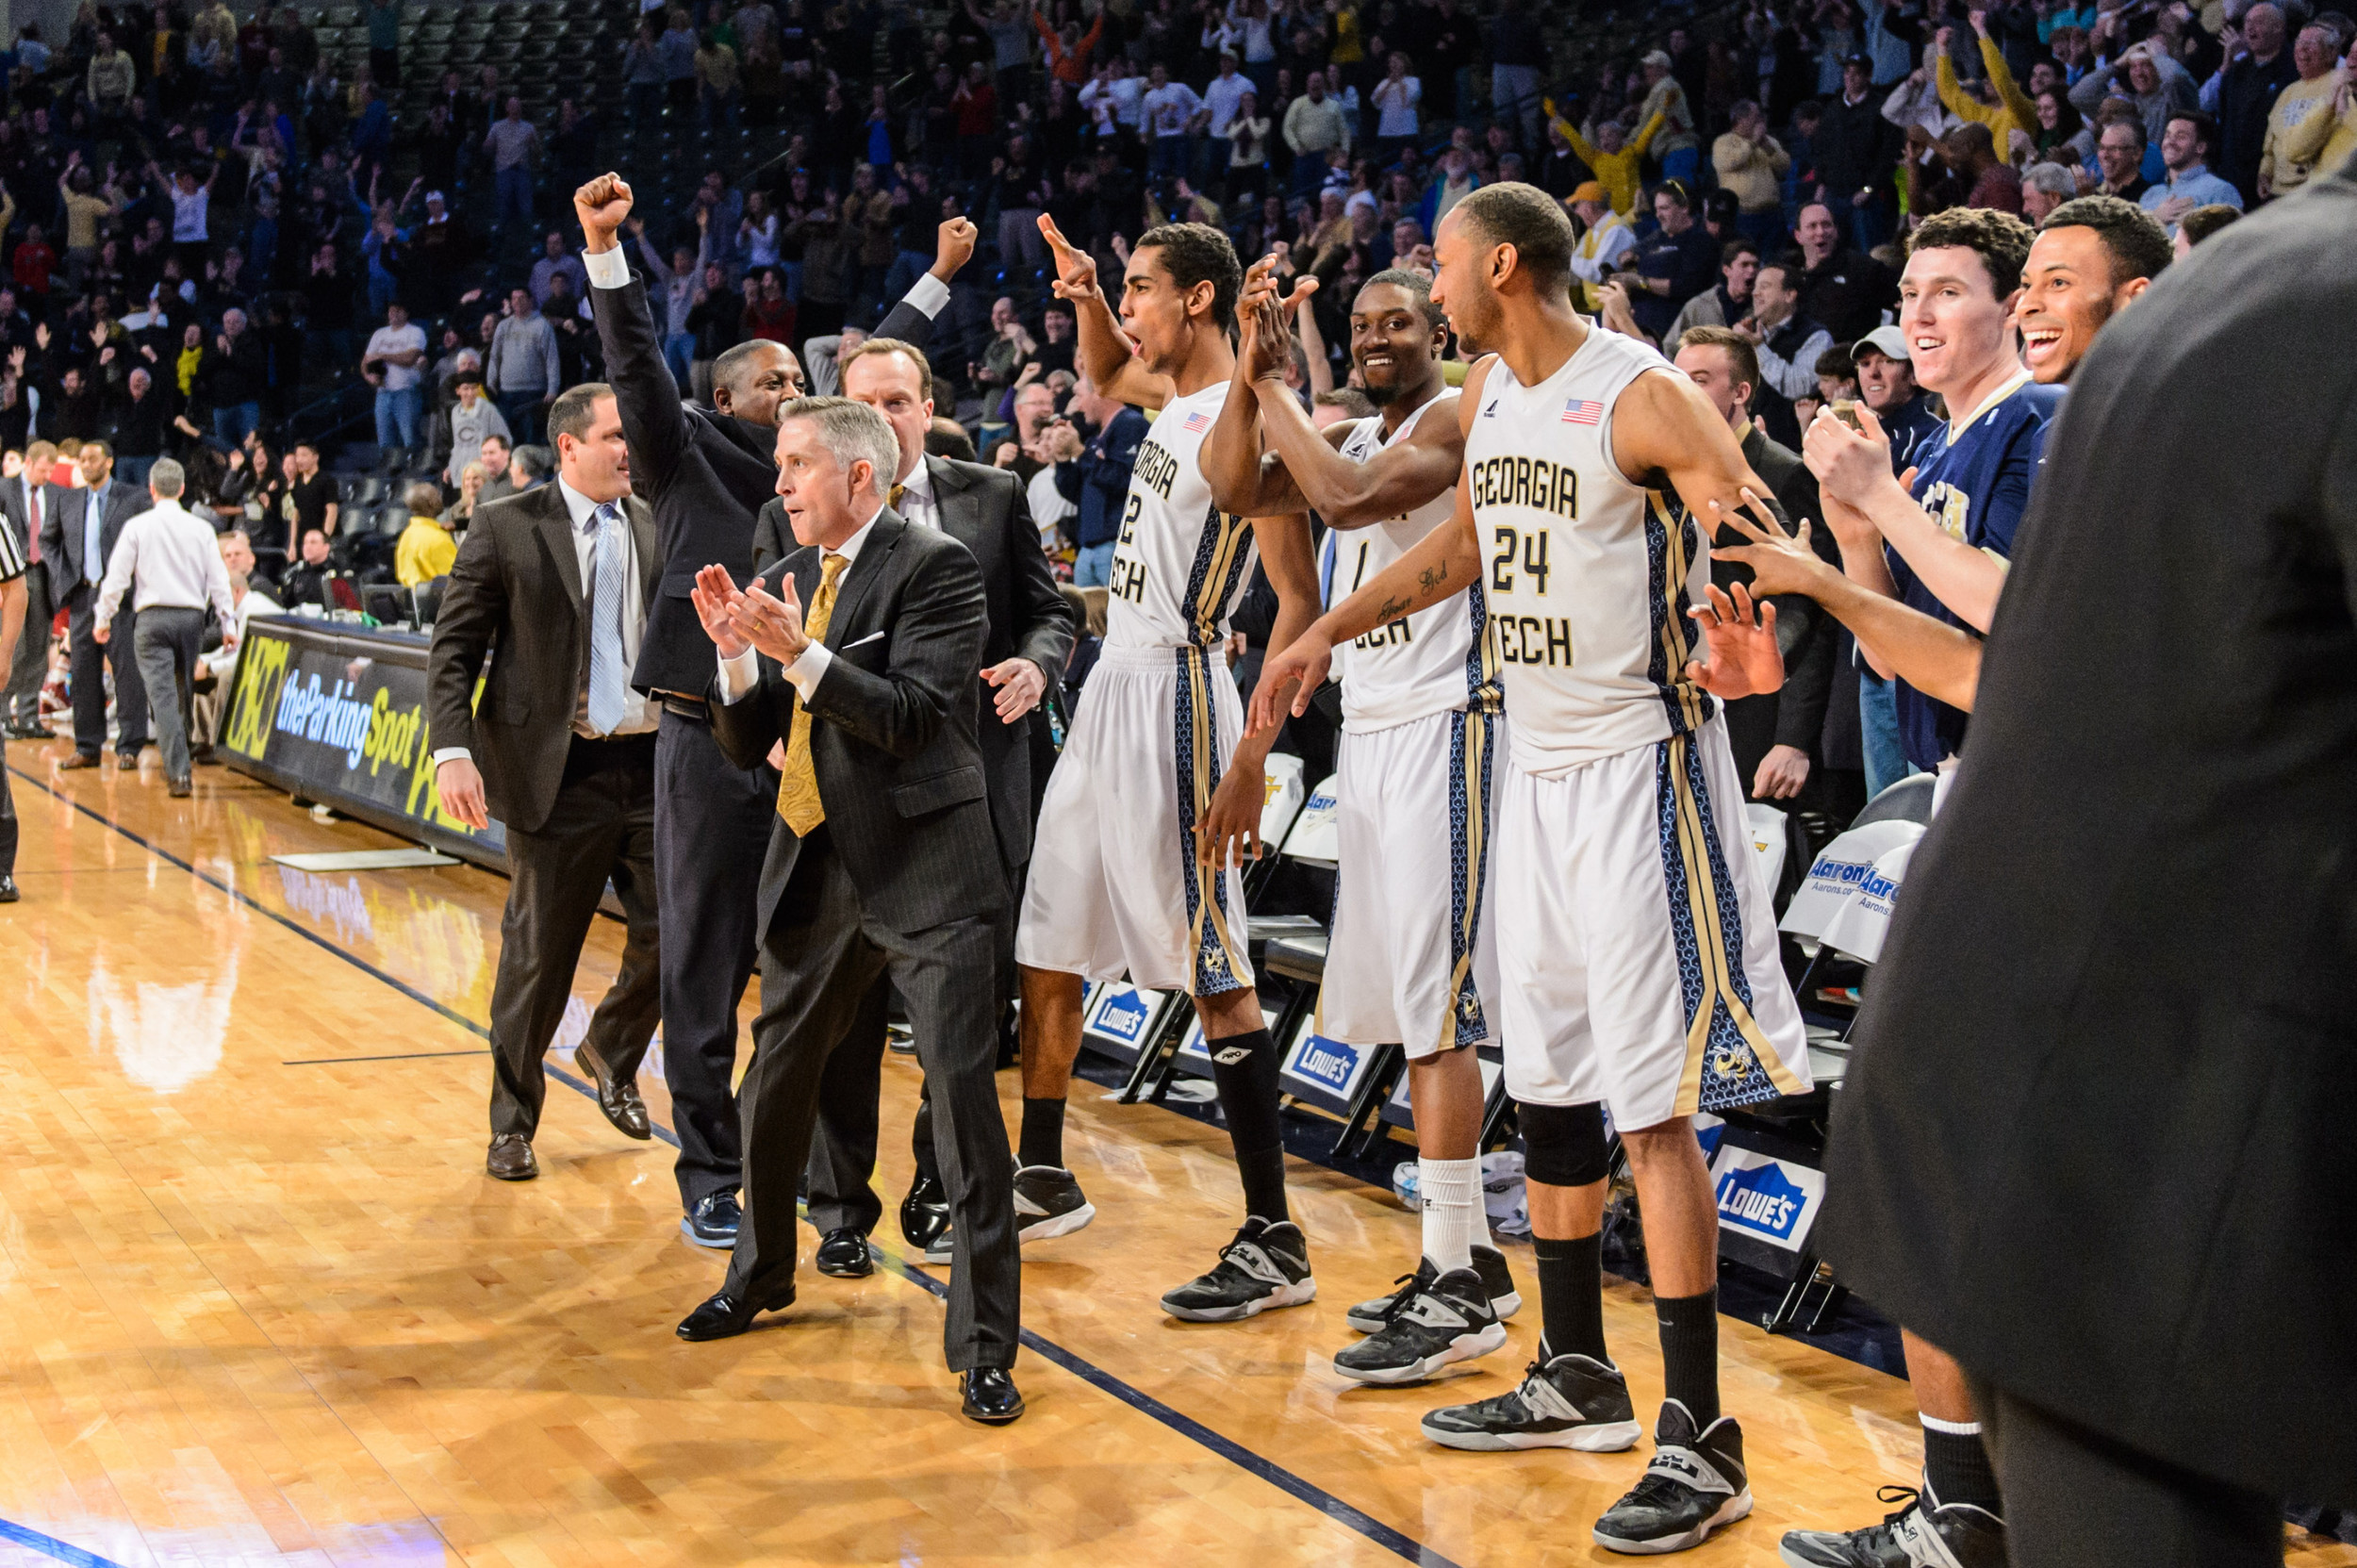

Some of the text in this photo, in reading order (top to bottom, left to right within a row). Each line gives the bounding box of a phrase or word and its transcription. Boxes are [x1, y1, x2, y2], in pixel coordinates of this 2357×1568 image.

[1133, 438, 1178, 503] ORGIA
[1474, 455, 1578, 521] GEORGIA
[1118, 489, 1142, 547] 2
[1111, 554, 1146, 604] ECH
[1492, 524, 1551, 596] 24
[1491, 613, 1574, 668] ECH
[1857, 869, 1901, 903] Aaro
[1097, 1001, 1144, 1035] LOWE'S
[1299, 1041, 1351, 1083] LOWE'S
[1718, 1179, 1794, 1230] LOWE'S
